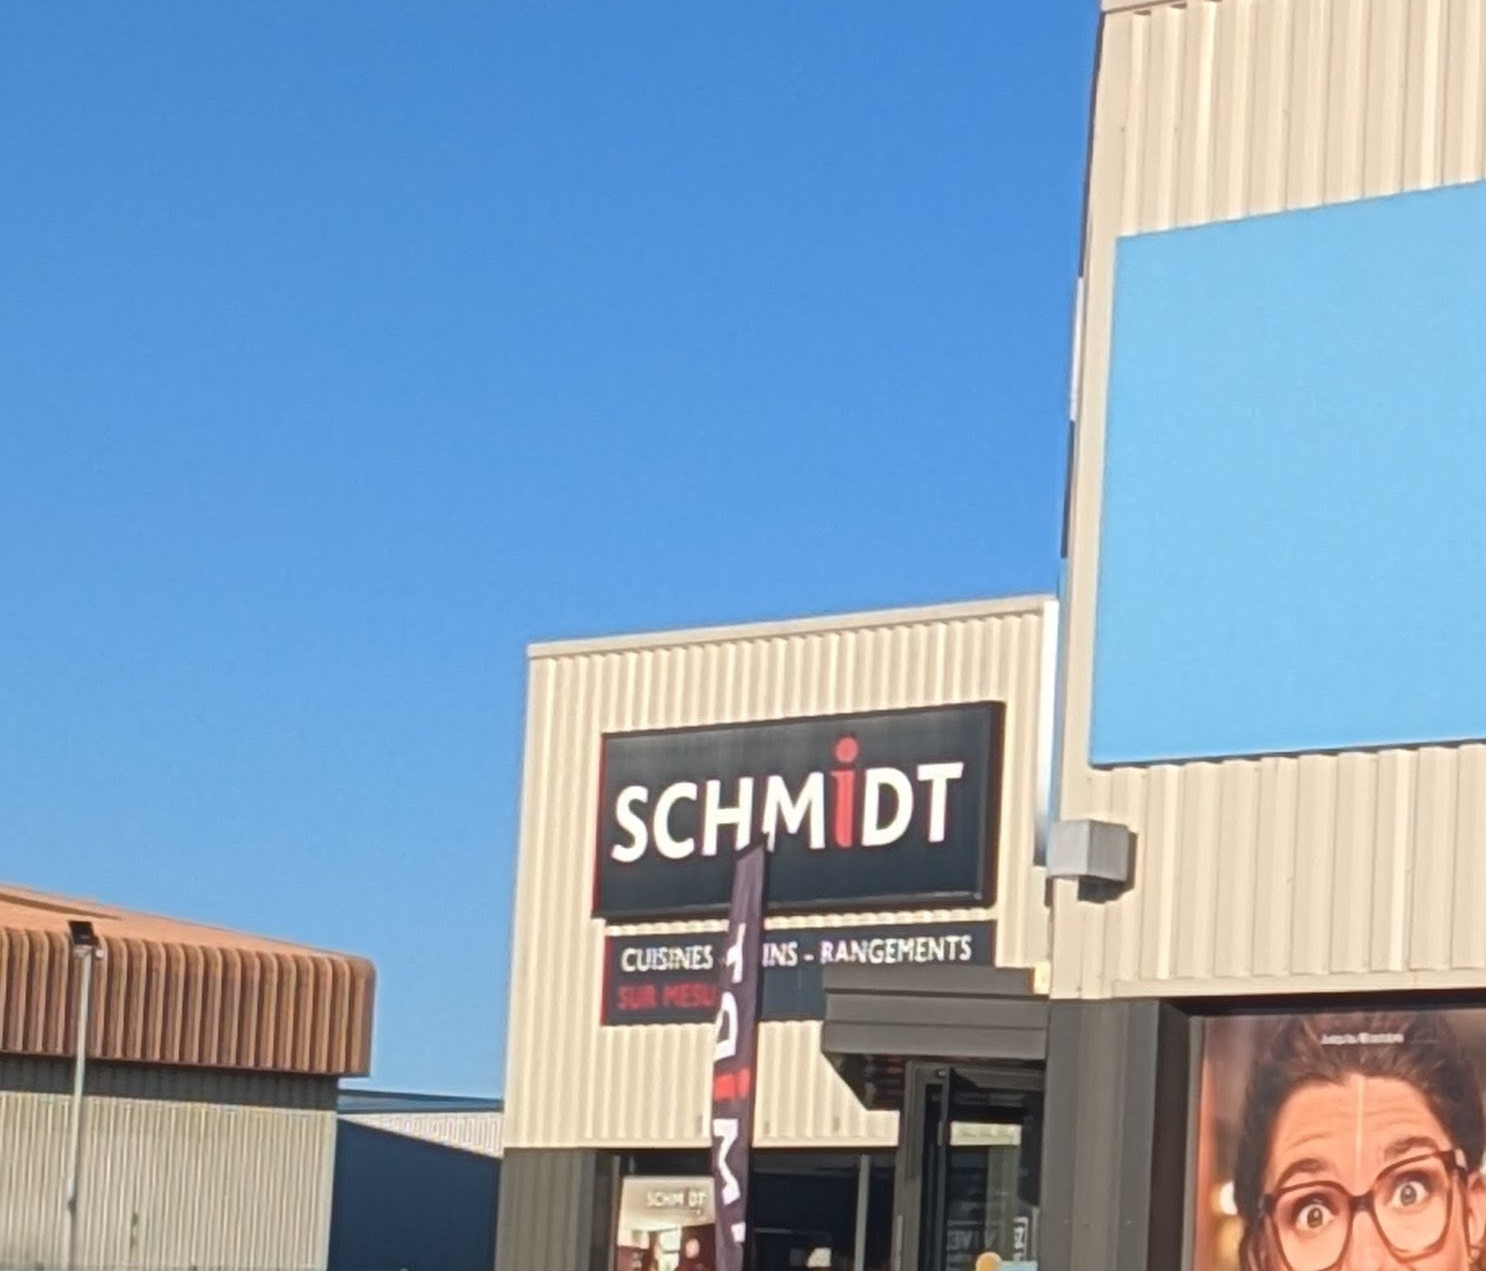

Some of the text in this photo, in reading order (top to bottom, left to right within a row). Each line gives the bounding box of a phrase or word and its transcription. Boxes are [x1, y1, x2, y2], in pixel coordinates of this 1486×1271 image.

[621, 944, 714, 972] CUISINES
[762, 941, 798, 967] INS
[820, 934, 973, 965] RANGEMENTS
[662, 981, 718, 1008] MESU
